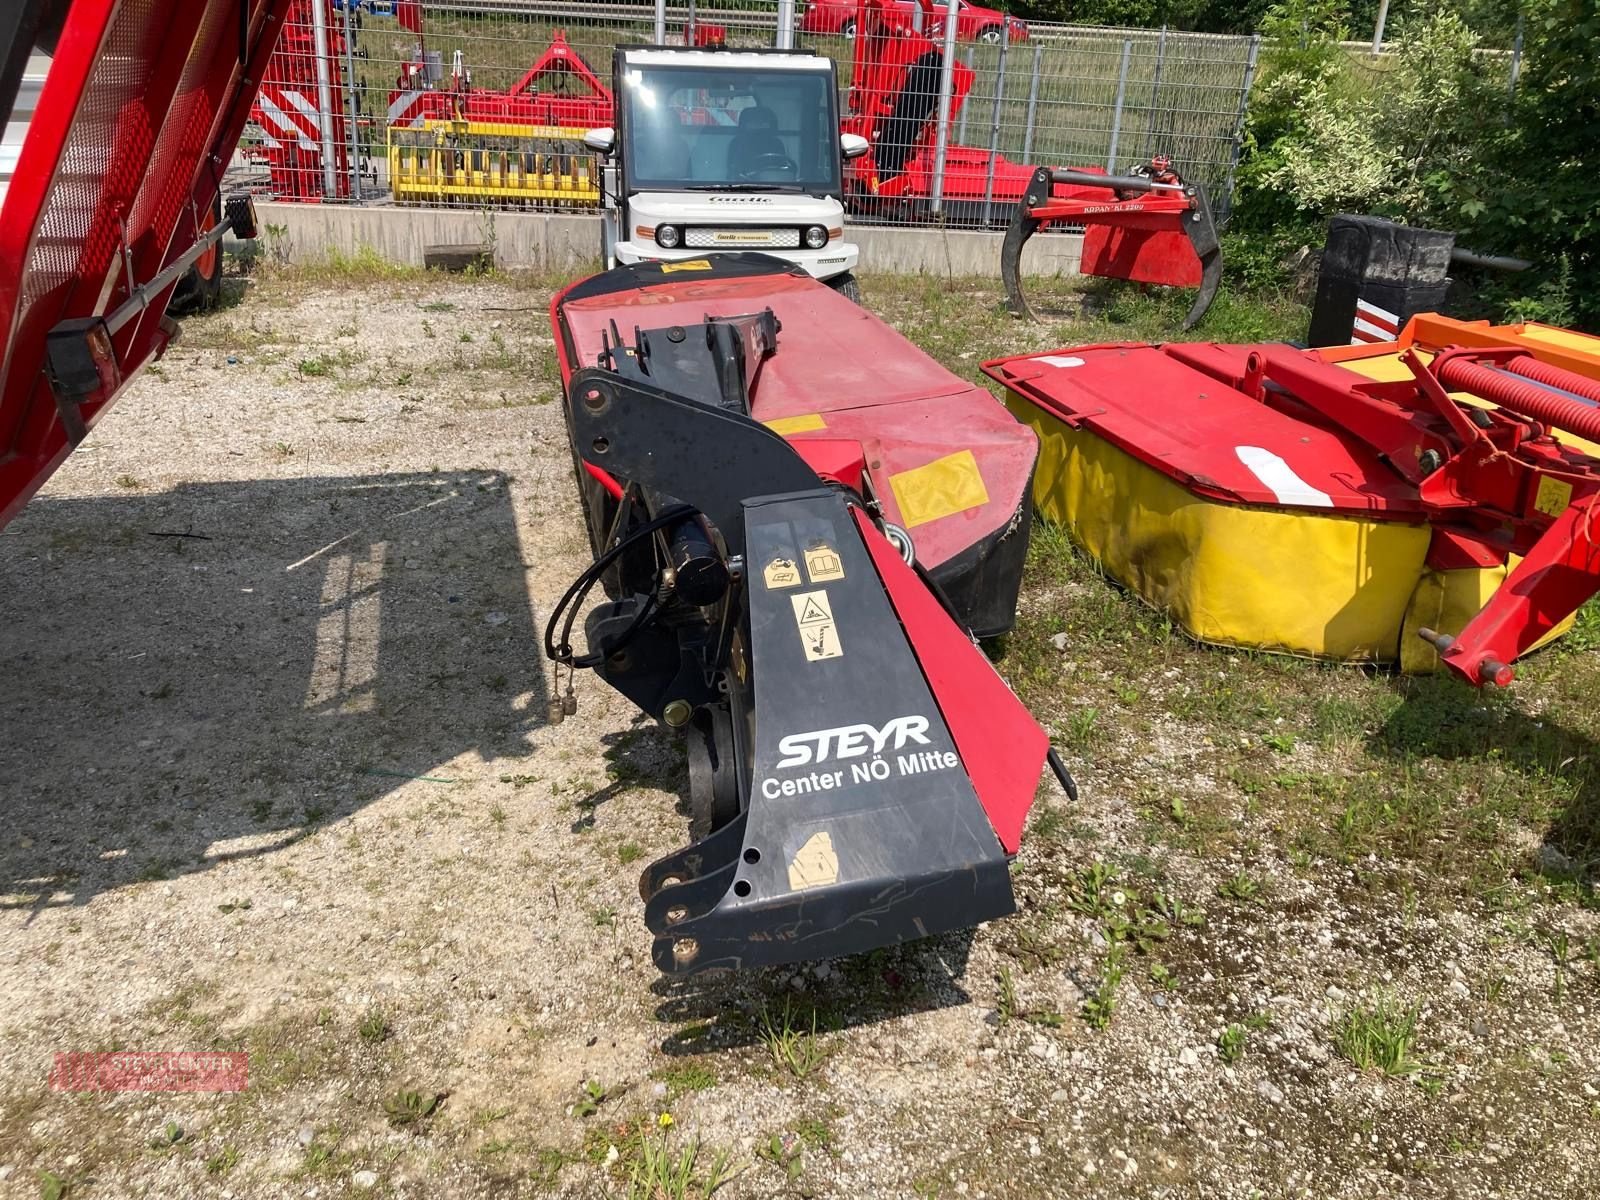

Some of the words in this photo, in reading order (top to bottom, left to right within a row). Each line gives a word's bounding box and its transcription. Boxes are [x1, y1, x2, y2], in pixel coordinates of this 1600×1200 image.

[776, 715, 932, 769] STEYR
[761, 770, 844, 799] Center
[850, 755, 890, 784] NÖ
[897, 751, 959, 776] Mitte
